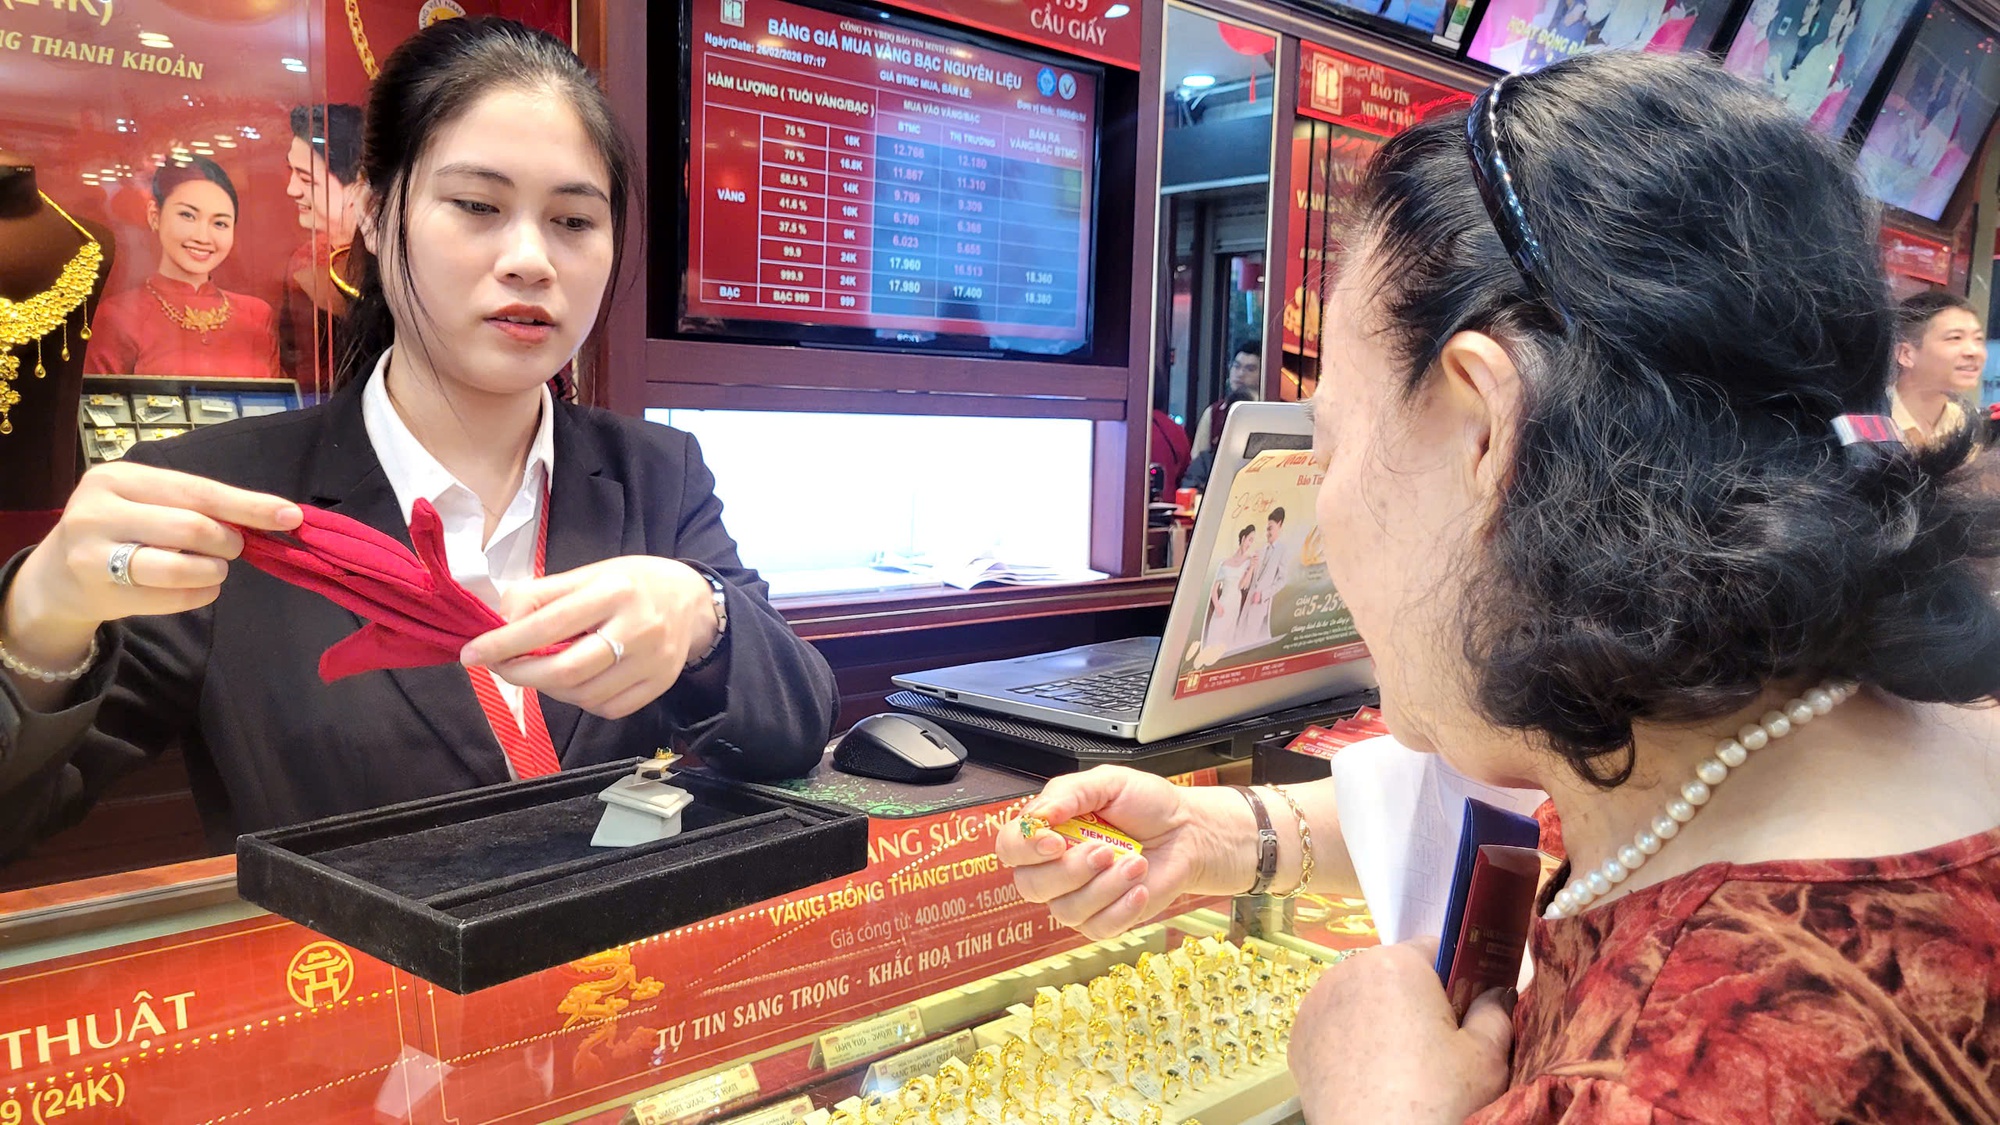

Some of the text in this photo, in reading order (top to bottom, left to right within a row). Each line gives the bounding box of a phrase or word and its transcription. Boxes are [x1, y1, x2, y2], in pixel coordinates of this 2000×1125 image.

[704, 32, 754, 54] Ngày/Date:
[1030, 3, 1107, 46] CẦU GIẤY
[30, 35, 115, 65] THANH
[121, 50, 204, 80] KHOẢN
[768, 17, 1022, 91] BẢNG GIÁ MUA VÀNG BẠC NGUYÊN LIỆU
[707, 70, 734, 91] HÀM
[736, 77, 779, 98] LƯỢNG
[787, 86, 814, 104] TUỔI
[814, 90, 869, 117] VÀNG/BẠC
[903, 99, 922, 113] MUA
[1360, 101, 1388, 120] MINH
[717, 187, 746, 204] VÀNG
[719, 286, 741, 300] BẠC
[868, 829, 923, 864] ANG
[929, 812, 980, 850] SỨC
[768, 853, 998, 928] VÀNG RỒNG THĂNG LONG
[830, 923, 855, 950] Giá
[857, 919, 892, 945] công
[894, 912, 912, 934] từ:
[915, 897, 966, 926] 400.000
[977, 882, 1021, 911] 15.000.
[656, 1020, 687, 1053] TỰ
[691, 1010, 726, 1041] TIN
[733, 994, 784, 1029] SANG
[790, 974, 850, 1010] TRỌNG
[868, 949, 913, 988] KHẮC
[918, 945, 951, 971] HOẠ
[956, 932, 993, 960] TÍNH
[997, 920, 1034, 948] CÁCH
[0, 990, 196, 1070] THUẬT
[32, 1072, 126, 1125] (24K)
